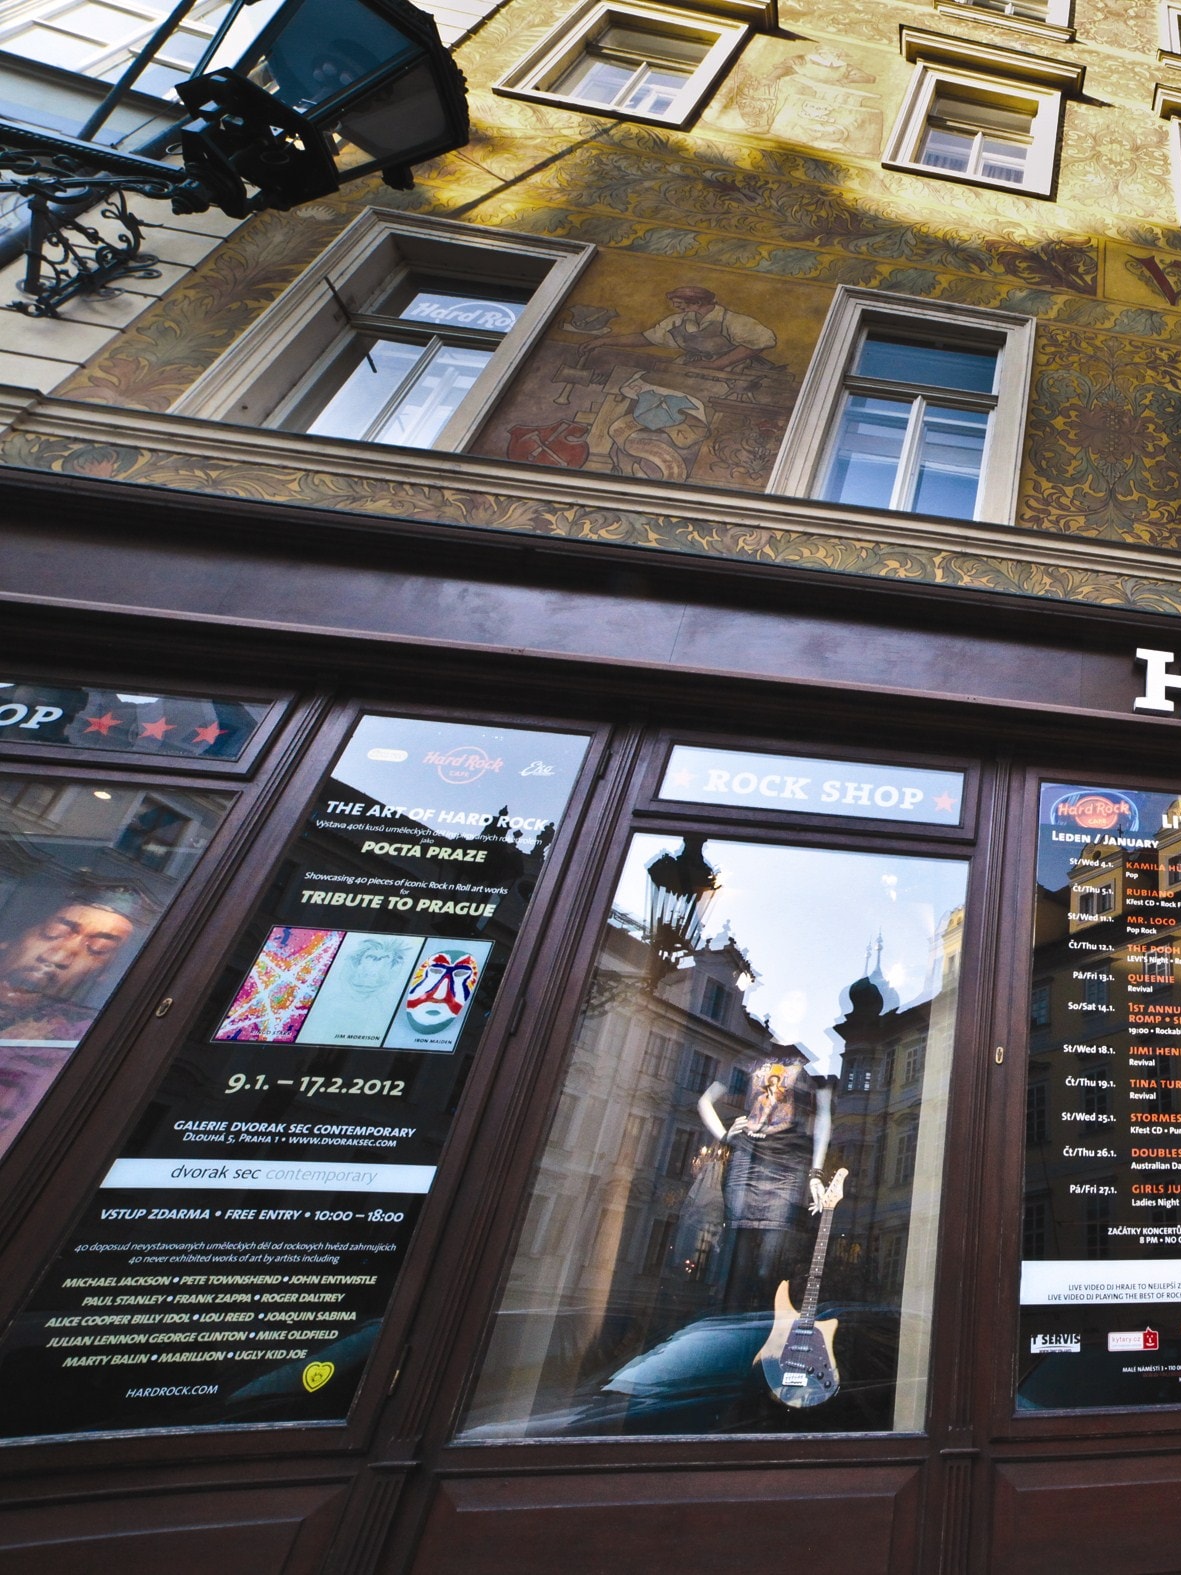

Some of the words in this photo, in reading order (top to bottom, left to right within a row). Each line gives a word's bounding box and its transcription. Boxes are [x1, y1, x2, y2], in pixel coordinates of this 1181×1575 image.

[411, 303, 480, 322] Hard
[423, 751, 466, 766] Hard
[466, 754, 504, 772] Rock
[703, 769, 812, 801] ROCK
[821, 779, 923, 810] SHOP
[1058, 802, 1095, 816] Hard
[1096, 802, 1130, 816] Rock
[326, 801, 365, 816] THE
[367, 804, 404, 819] ART
[409, 807, 436, 821] OF
[438, 811, 494, 827] HARD
[496, 816, 549, 831] ROCK
[1052, 830, 1092, 843] LEDEN
[1102, 834, 1159, 849] JANUARY
[361, 841, 422, 858] POCTA
[426, 847, 488, 863] PRAZE
[1126, 862, 1166, 872] KAMILA
[304, 871, 354, 885] Showcasing
[354, 877, 367, 885] 40
[367, 877, 393, 887] pieces
[394, 878, 404, 888] of
[404, 879, 427, 889] iconic
[429, 881, 447, 890] Rock
[455, 882, 470, 892] Roll
[484, 887, 508, 895] works
[1126, 888, 1175, 898] RUBIANO
[301, 890, 385, 908] TRIBUTE
[387, 896, 413, 910] TO
[416, 900, 496, 917] PRAGUE
[1127, 916, 1146, 925] MR.
[1150, 917, 1176, 926] LOCO
[1127, 944, 1148, 953] THE
[1150, 945, 1181, 955] POOH
[1128, 974, 1175, 985] QUEENIE
[1127, 985, 1153, 993] Revival
[1128, 1003, 1145, 1013] 1ST
[1129, 1015, 1162, 1024] ROMP
[1063, 1044, 1096, 1054] St/Wed
[1098, 1045, 1116, 1054] 18.1.
[1129, 1046, 1154, 1056] JIMI
[225, 1073, 270, 1094] 9.1.
[300, 1076, 406, 1097] 17.2.2012
[1098, 1080, 1116, 1088] 19.1.
[1130, 1079, 1157, 1088] TINA
[1061, 1112, 1096, 1122] St/Wed
[1097, 1114, 1117, 1124] 25.1.
[173, 1120, 228, 1132] GALERIE
[231, 1122, 286, 1134] DVORAK
[289, 1124, 311, 1135] SEC
[313, 1124, 416, 1138] CONTEMPORARY
[1096, 1148, 1117, 1157] 26.1.
[1131, 1162, 1170, 1170] Australian
[171, 1165, 230, 1180] dvorak
[233, 1167, 262, 1180] sec
[266, 1167, 378, 1185] contemporary
[1070, 1184, 1097, 1194] Pá/Fri
[1098, 1186, 1118, 1195] 27.1.
[1132, 1184, 1164, 1194] GIRLS
[1131, 1198, 1156, 1207] Ladies
[1157, 1198, 1180, 1208] Night
[100, 1209, 147, 1220] VSTUP
[148, 1209, 211, 1220] ZDARMA
[225, 1209, 257, 1220] FREE
[259, 1210, 302, 1221] ENTRY
[314, 1210, 354, 1222] 10:00
[367, 1211, 404, 1223] 18:00
[1146, 1236, 1159, 1244] PM
[1164, 1236, 1178, 1244] NO
[62, 1276, 118, 1288] MICHAEL
[116, 1276, 173, 1287] JACKSON
[180, 1275, 207, 1285] PETE
[208, 1275, 282, 1285] TOWNSHEND
[288, 1275, 321, 1285] JOHN
[320, 1275, 377, 1284] ENTWISTLE
[62, 1356, 111, 1368] MARTY
[110, 1354, 150, 1365] BALIN
[158, 1351, 225, 1362] MARILLION
[234, 1350, 266, 1360] UGLY
[265, 1349, 286, 1359] KID
[285, 1349, 308, 1359] JOE
[125, 1385, 219, 1399] HARDROCK.COM
